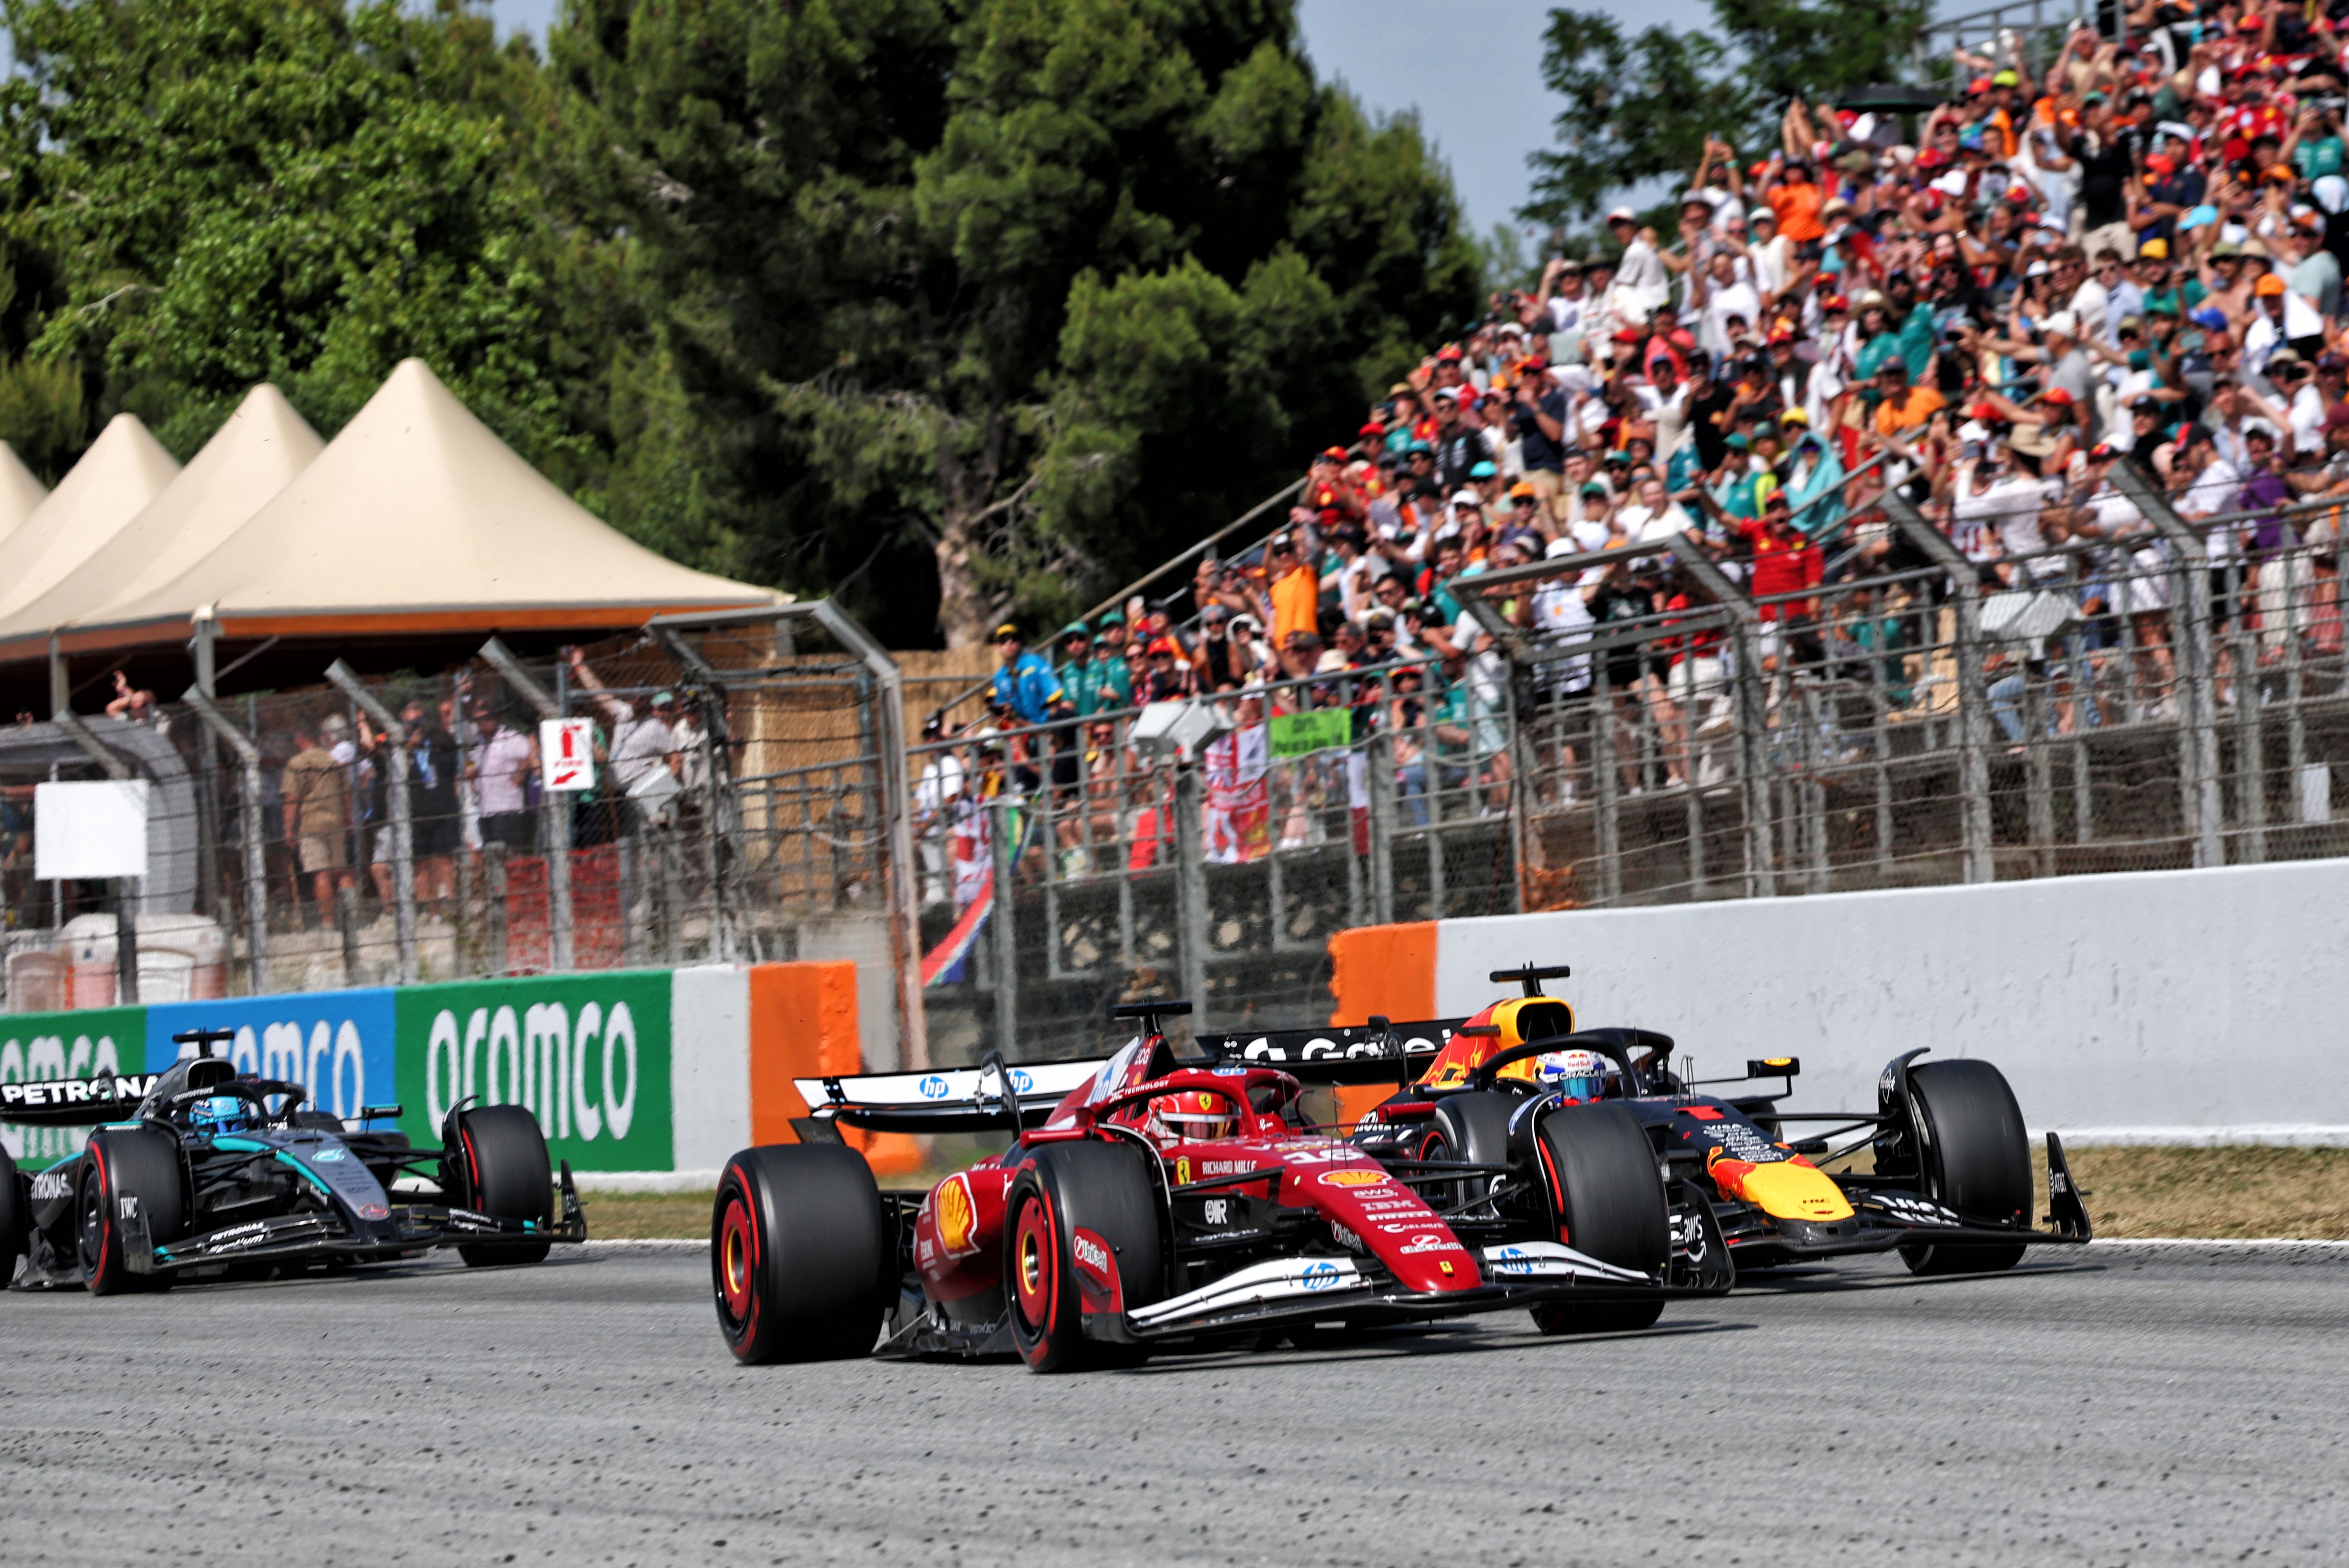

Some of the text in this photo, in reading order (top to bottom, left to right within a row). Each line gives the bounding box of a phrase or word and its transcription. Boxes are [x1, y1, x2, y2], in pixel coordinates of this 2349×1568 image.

[178, 1019, 365, 1133] amco
[426, 1001, 637, 1141] aramco
[1007, 1070, 1033, 1092] hp
[1559, 1070, 1600, 1080] ORACLE
[920, 1076, 949, 1099] hp
[1125, 1079, 1169, 1095] TECHNOLOGY
[1283, 1148, 1365, 1164] 16
[1202, 1162, 1233, 1175] RICHARD
[1353, 1188, 1395, 1197] aws
[2055, 1172, 2067, 1194] AT&T
[120, 1197, 138, 1219] IWC
[1360, 1200, 1416, 1211] IBM
[1366, 1210, 1433, 1221] PIRELLI
[210, 1222, 264, 1242] PETRONAS
[1684, 1214, 1703, 1244] aws
[1305, 1262, 1340, 1291] hp
